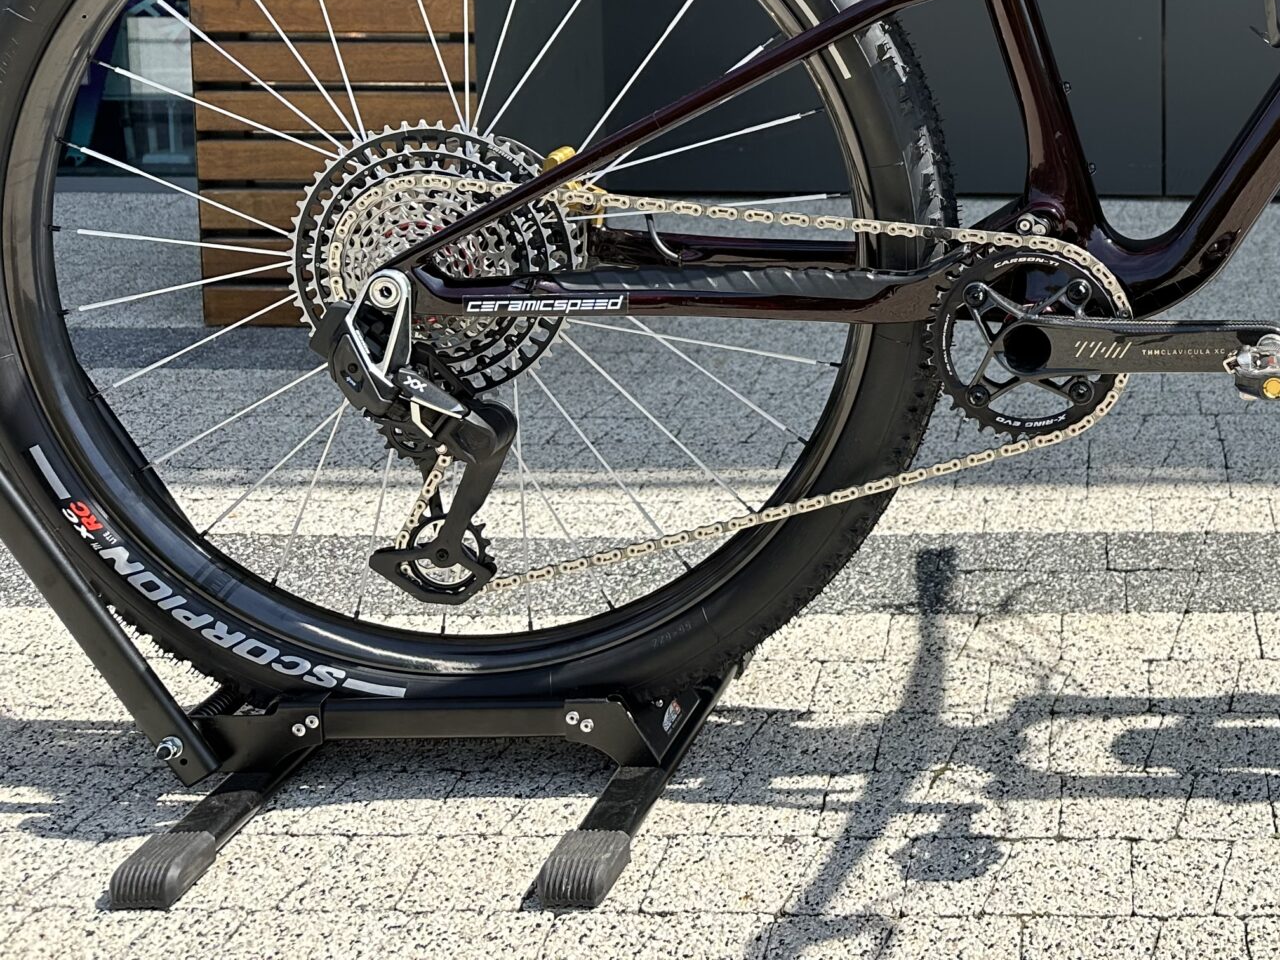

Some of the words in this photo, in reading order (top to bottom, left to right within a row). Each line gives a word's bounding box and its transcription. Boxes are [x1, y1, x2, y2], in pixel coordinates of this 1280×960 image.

[993, 255, 1060, 270] CARBON-TI
[994, 415, 1021, 427] EVO
[1023, 412, 1066, 428] X-RING
[62, 508, 94, 540] XC
[68, 500, 104, 533] RC
[103, 530, 118, 544] LITE
[100, 546, 346, 689] SCORPION
